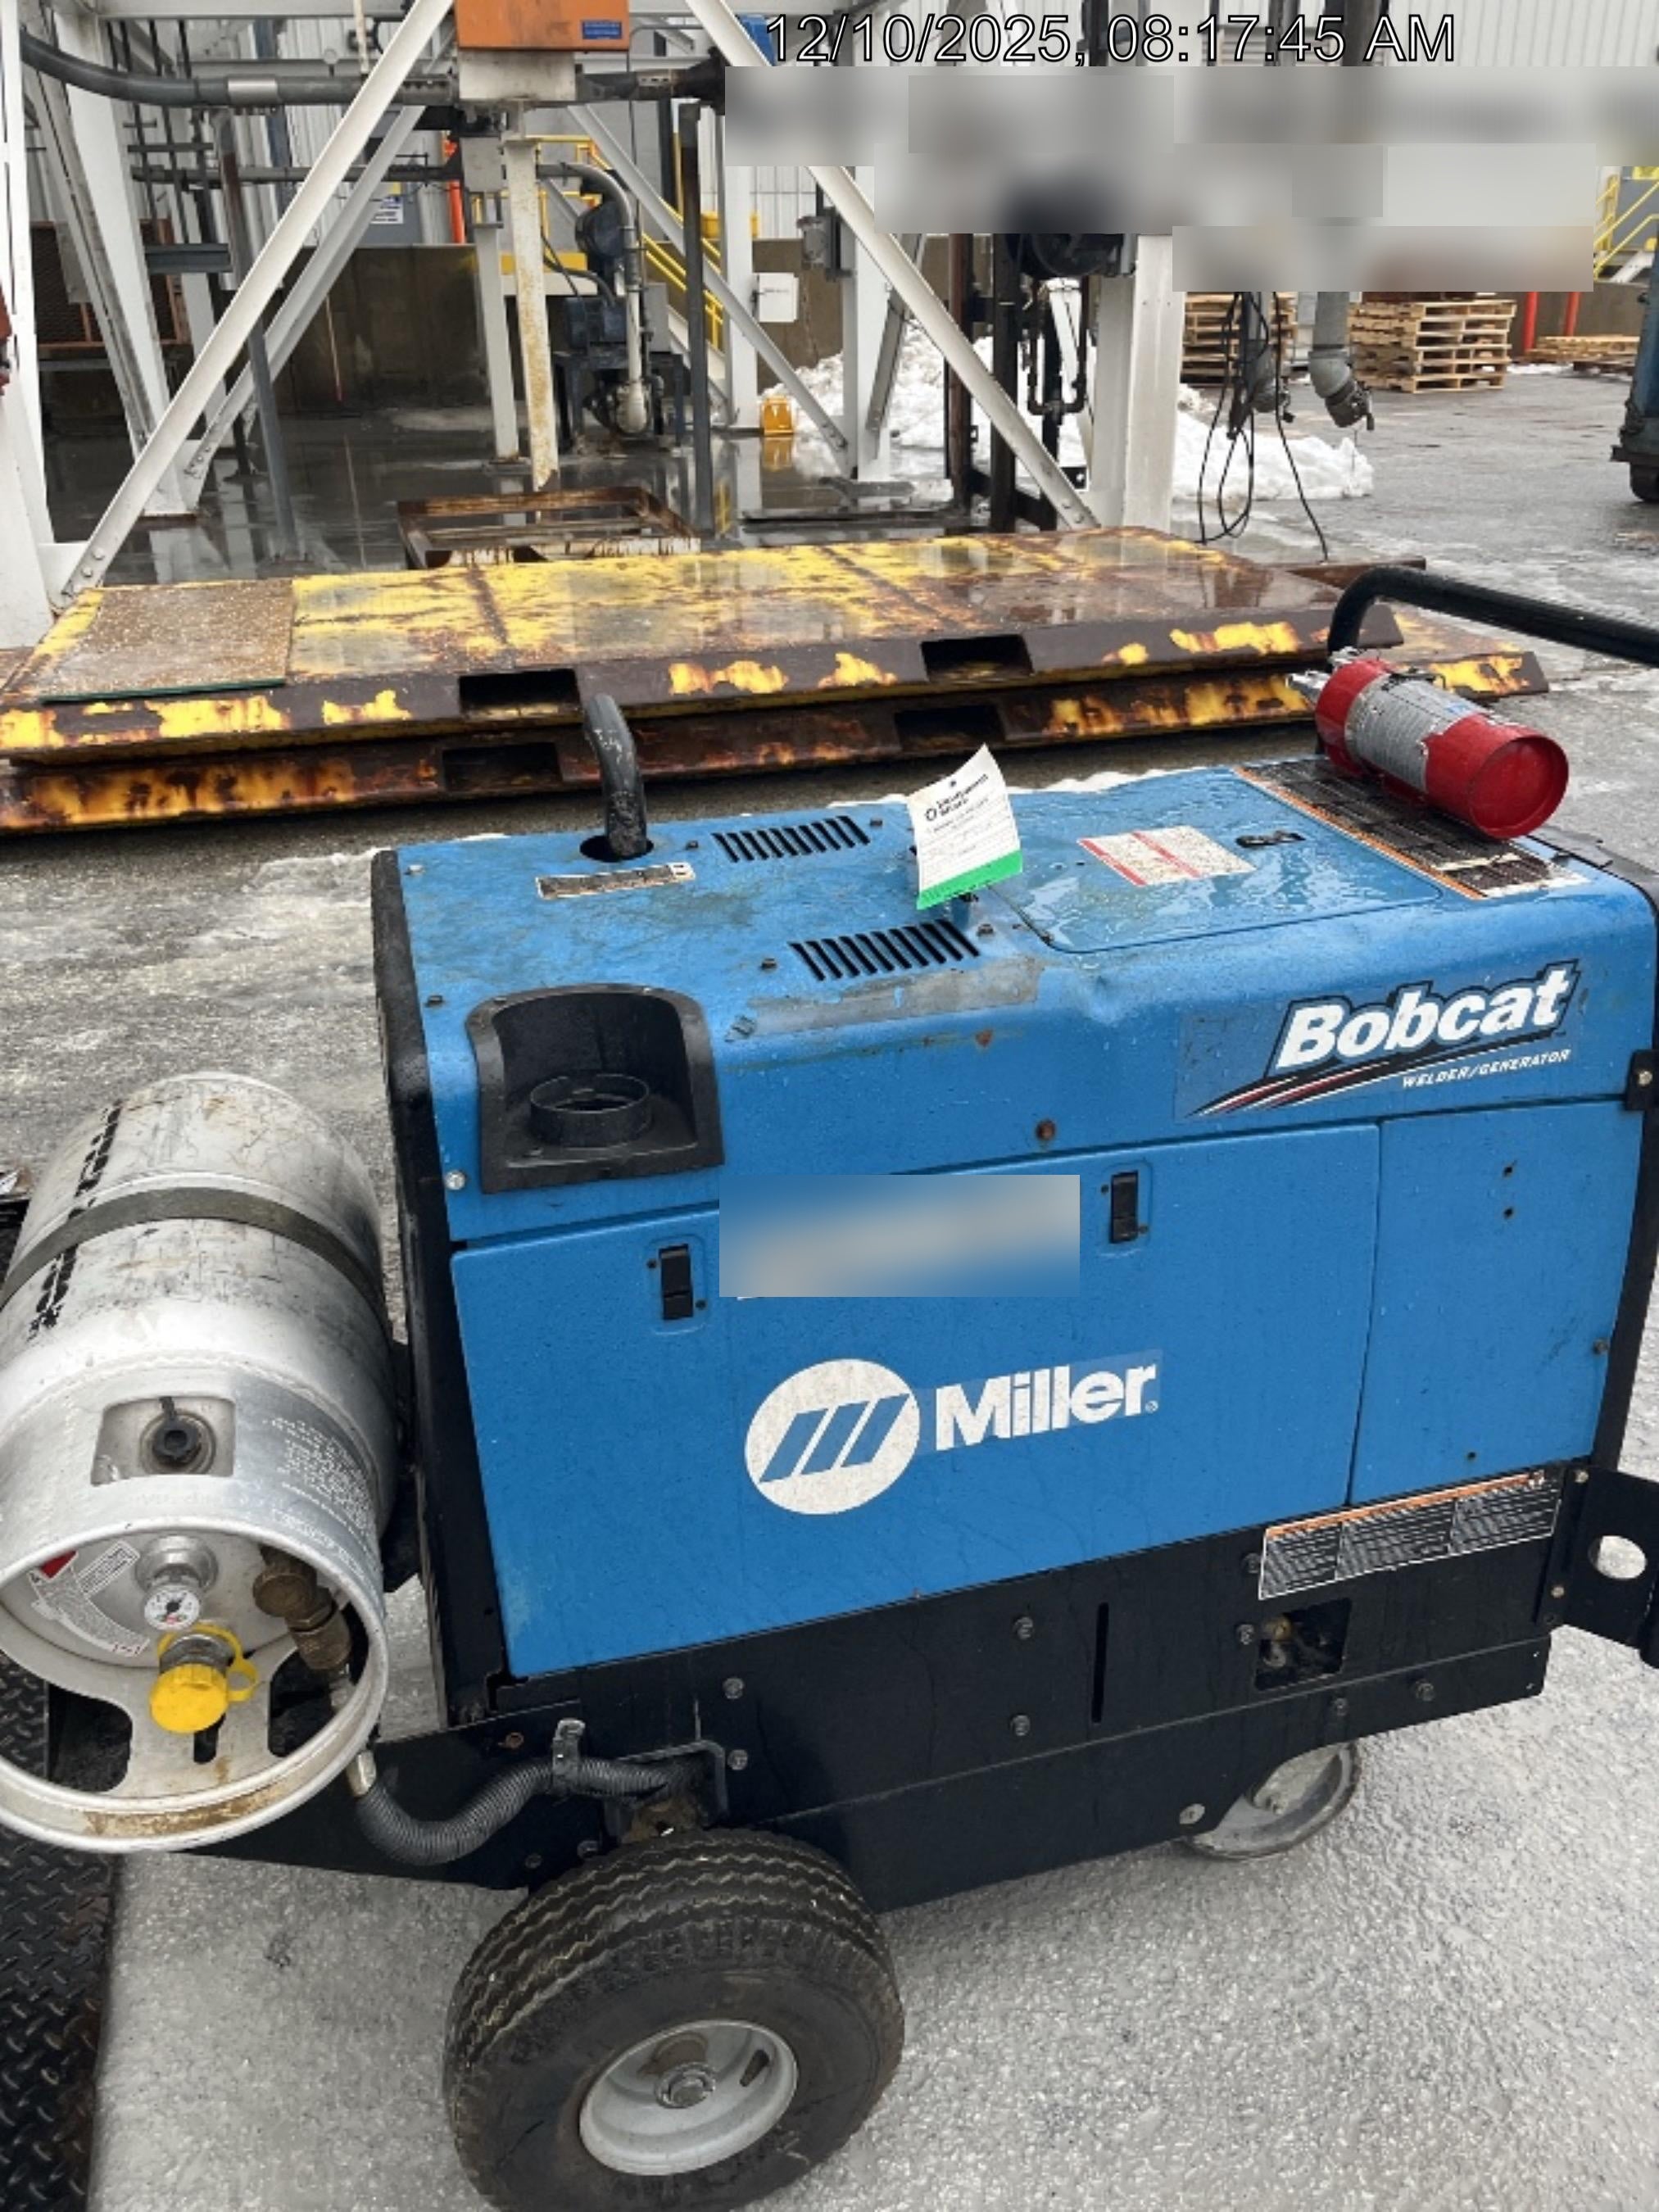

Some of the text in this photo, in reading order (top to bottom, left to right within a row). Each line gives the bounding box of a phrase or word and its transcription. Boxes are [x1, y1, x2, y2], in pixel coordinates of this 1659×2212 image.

[1274, 967, 1571, 1070] Bobcat
[1402, 1049, 1571, 1089] WELDER/GENERATOR
[936, 1364, 1157, 1451] Miller
